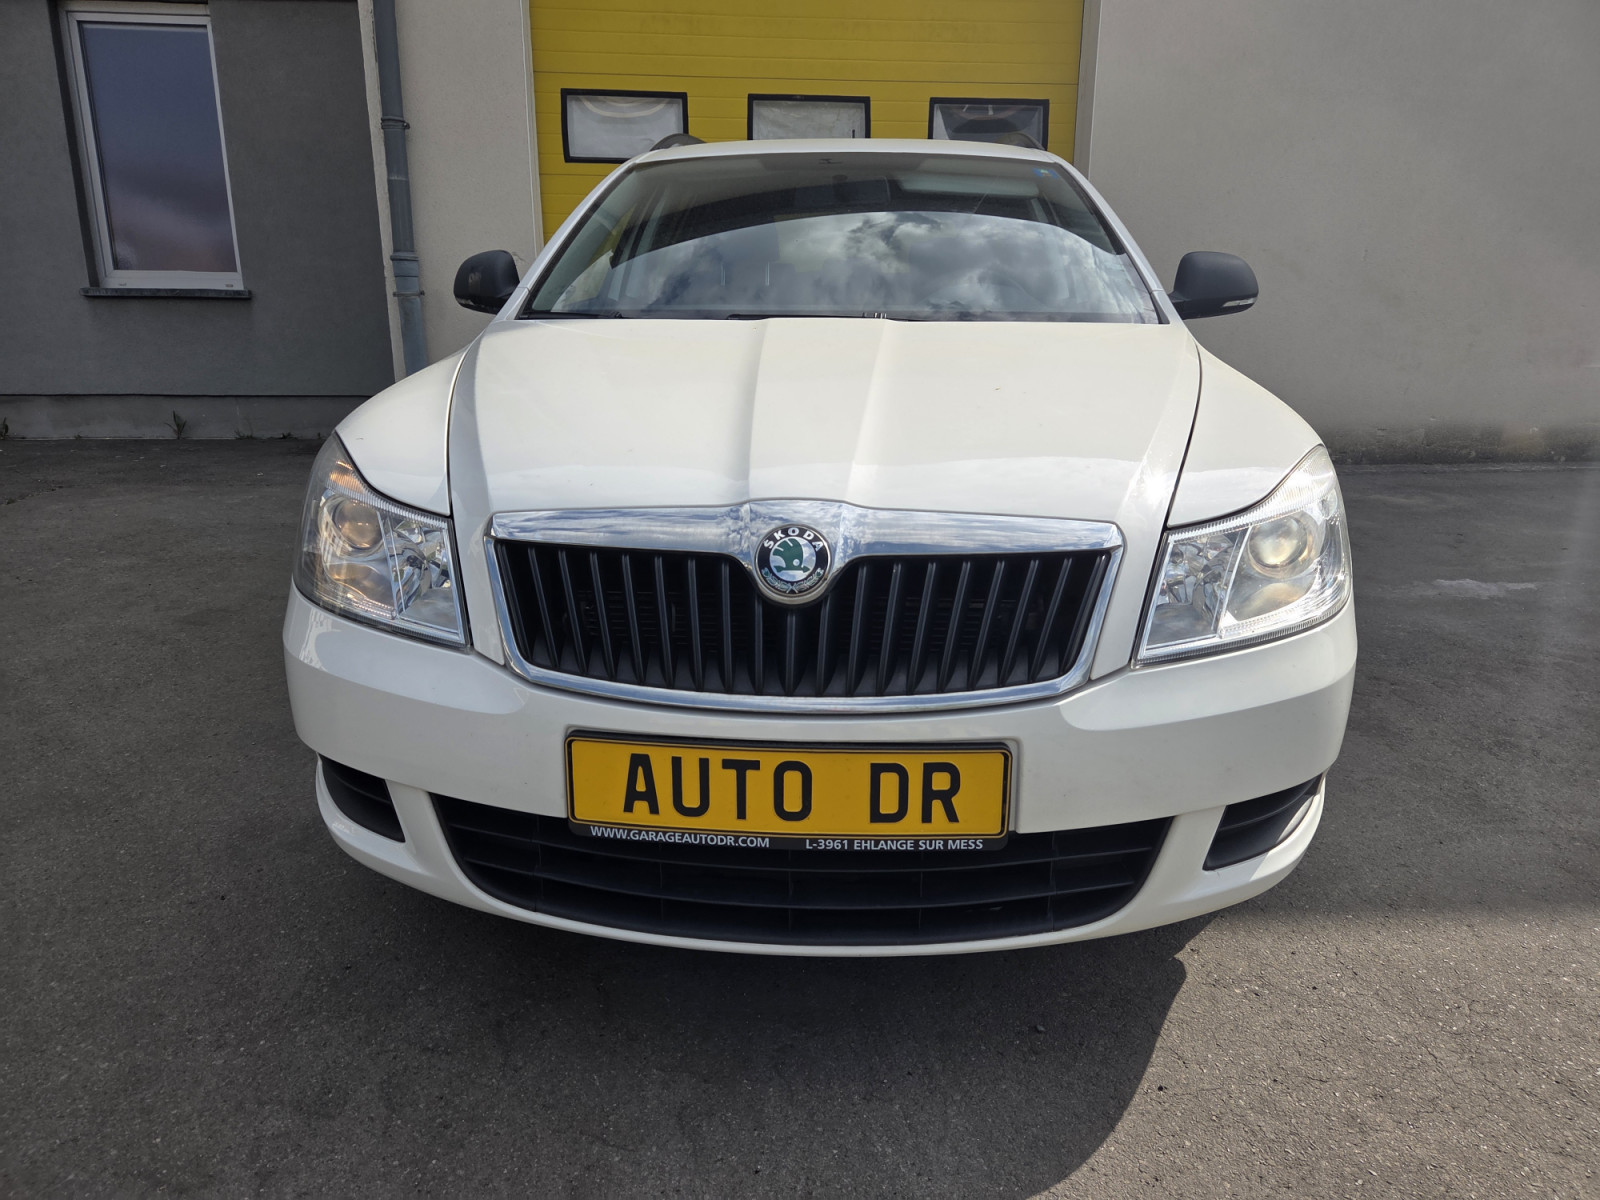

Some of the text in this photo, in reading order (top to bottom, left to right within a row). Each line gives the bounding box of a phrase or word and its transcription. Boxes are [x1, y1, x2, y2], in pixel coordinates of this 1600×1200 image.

[623, 753, 961, 824] AUTO DR
[590, 825, 770, 848] WWW.GARAGEAUTODR.COM
[805, 839, 984, 851] L-3961 EHLANGE SUR MESS
